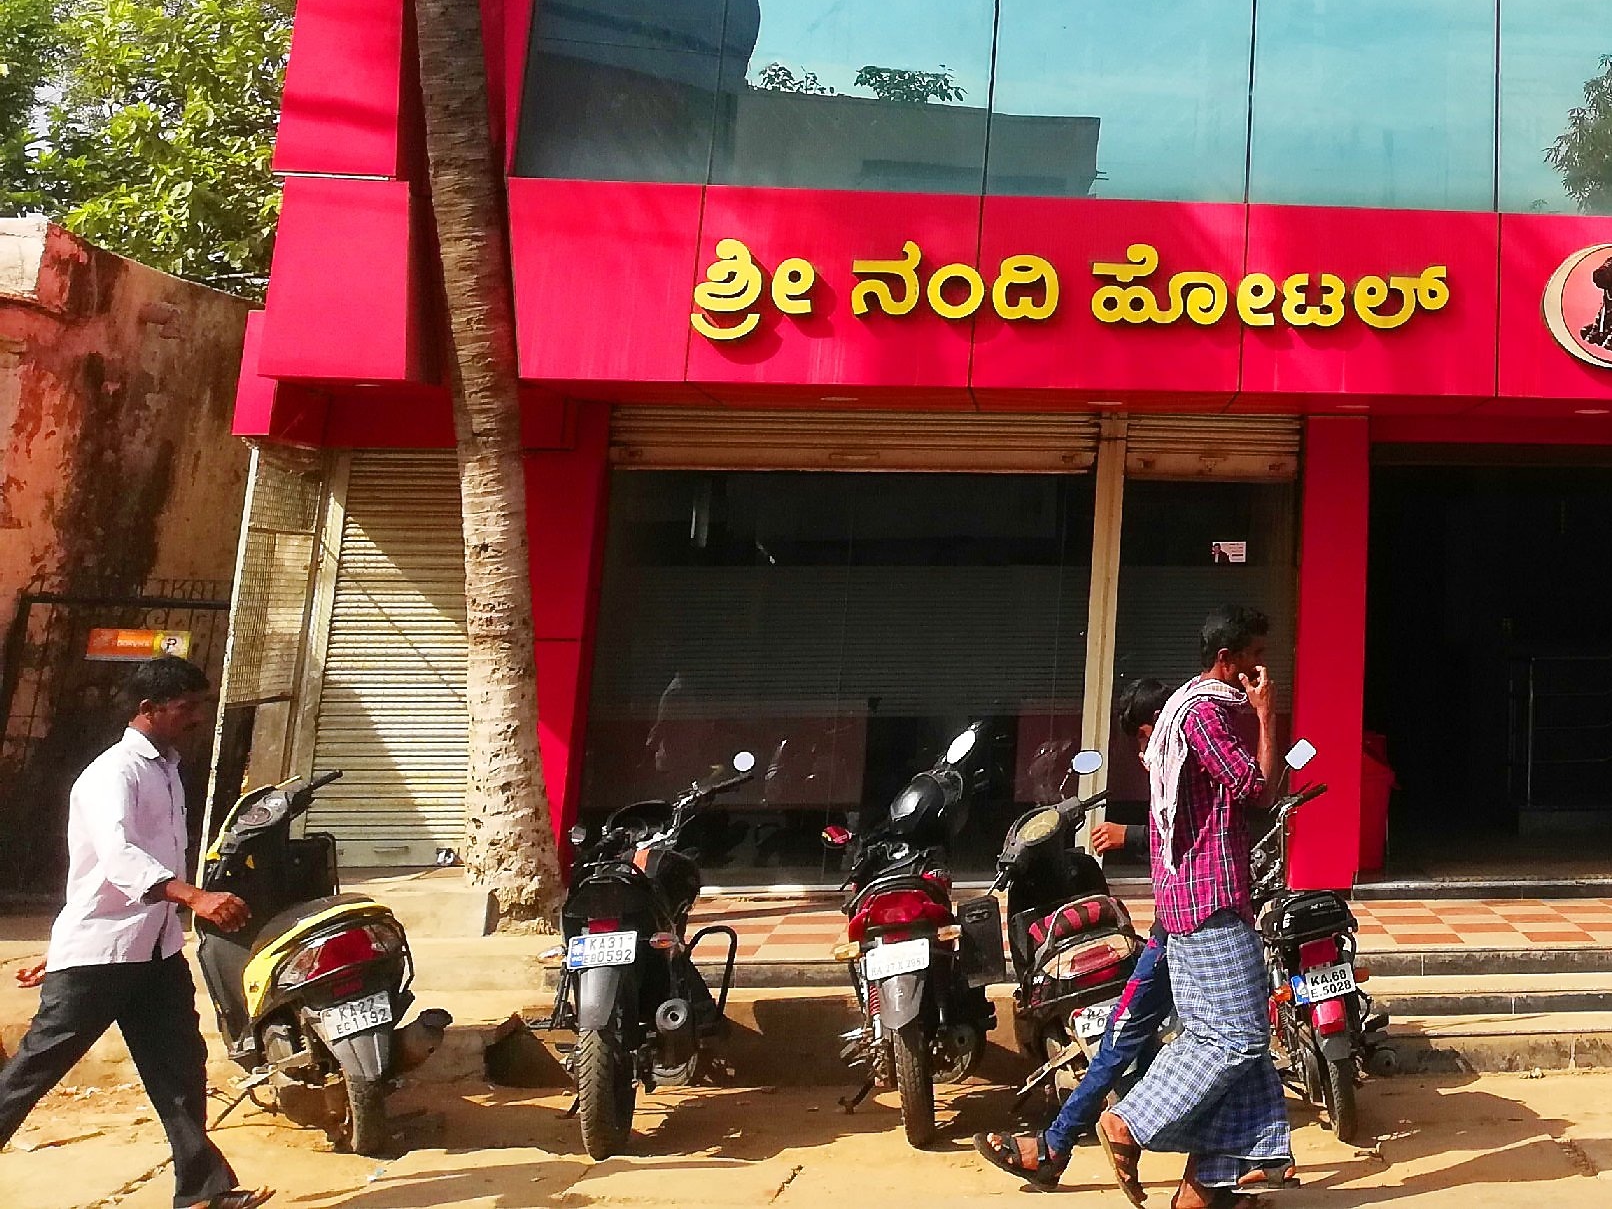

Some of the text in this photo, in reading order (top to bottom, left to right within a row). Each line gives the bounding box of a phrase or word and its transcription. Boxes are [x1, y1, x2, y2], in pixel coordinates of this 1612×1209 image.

[691, 238, 1448, 340] ಶ್ರೀ ನಂದಿ ಹೋಟಲ್
[589, 936, 624, 950] KA31
